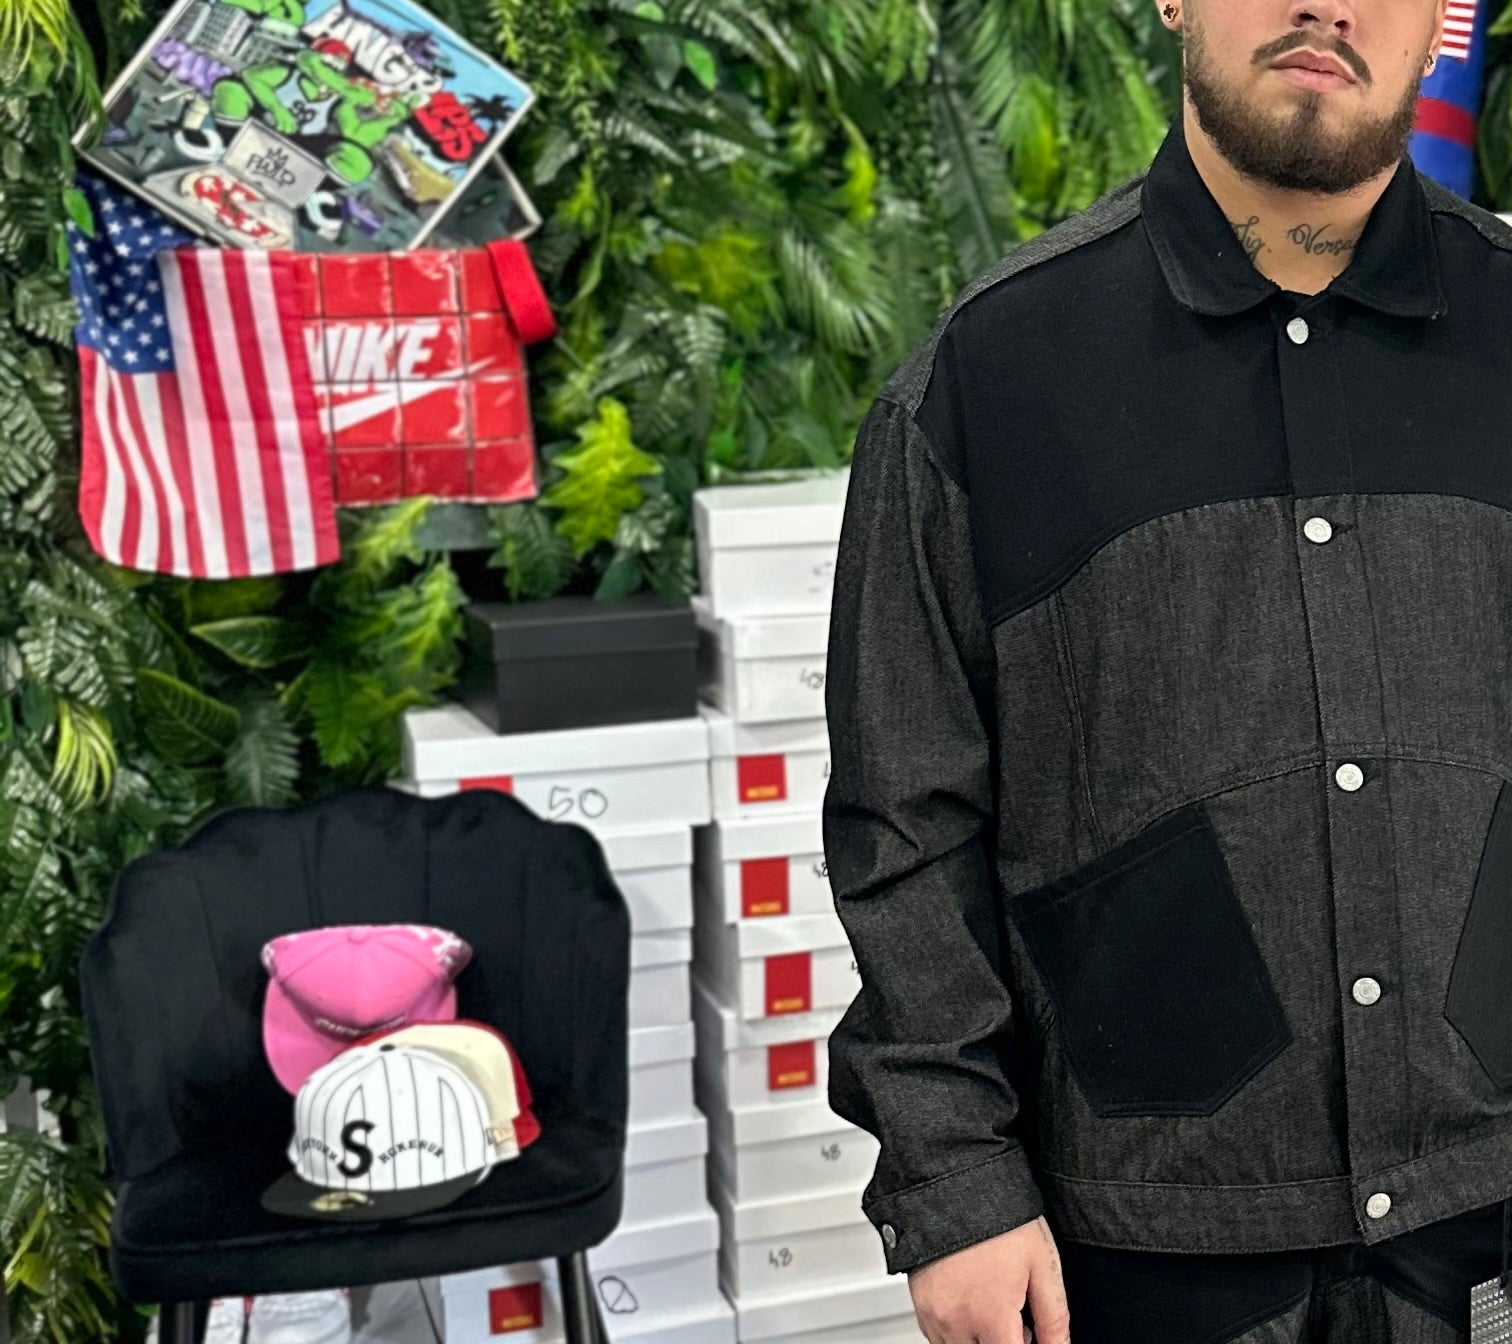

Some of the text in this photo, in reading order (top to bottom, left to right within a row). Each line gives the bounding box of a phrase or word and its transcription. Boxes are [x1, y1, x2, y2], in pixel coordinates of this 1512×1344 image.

[548, 785, 608, 820] 50
[336, 1119, 376, 1179] S
[768, 1246, 793, 1269] 48
